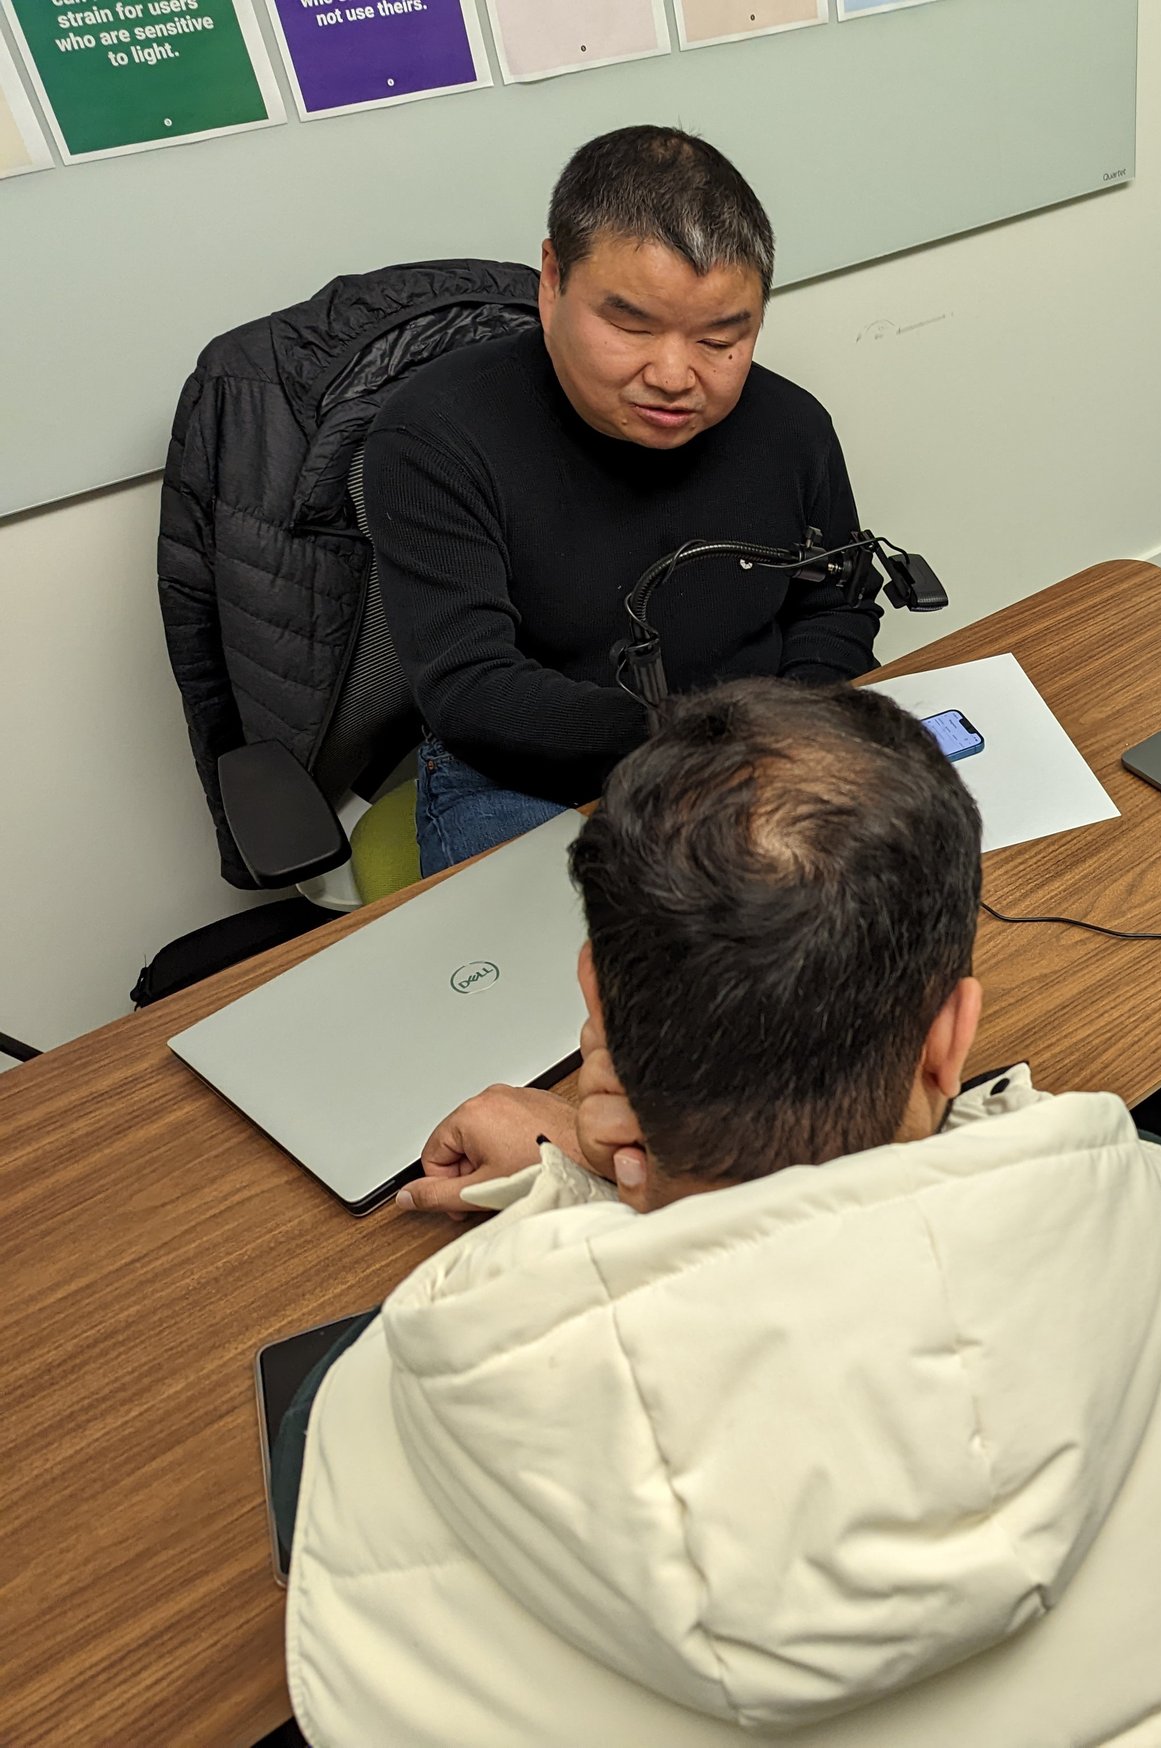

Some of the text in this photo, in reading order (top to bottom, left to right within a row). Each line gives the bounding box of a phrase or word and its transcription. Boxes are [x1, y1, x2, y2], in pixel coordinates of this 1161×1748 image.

[58, 0, 198, 28] strain for users
[316, 0, 428, 26] not use theirs.
[55, 15, 214, 52] who are sensitive
[108, 42, 180, 66] to light.
[458, 967, 494, 989] DELL
